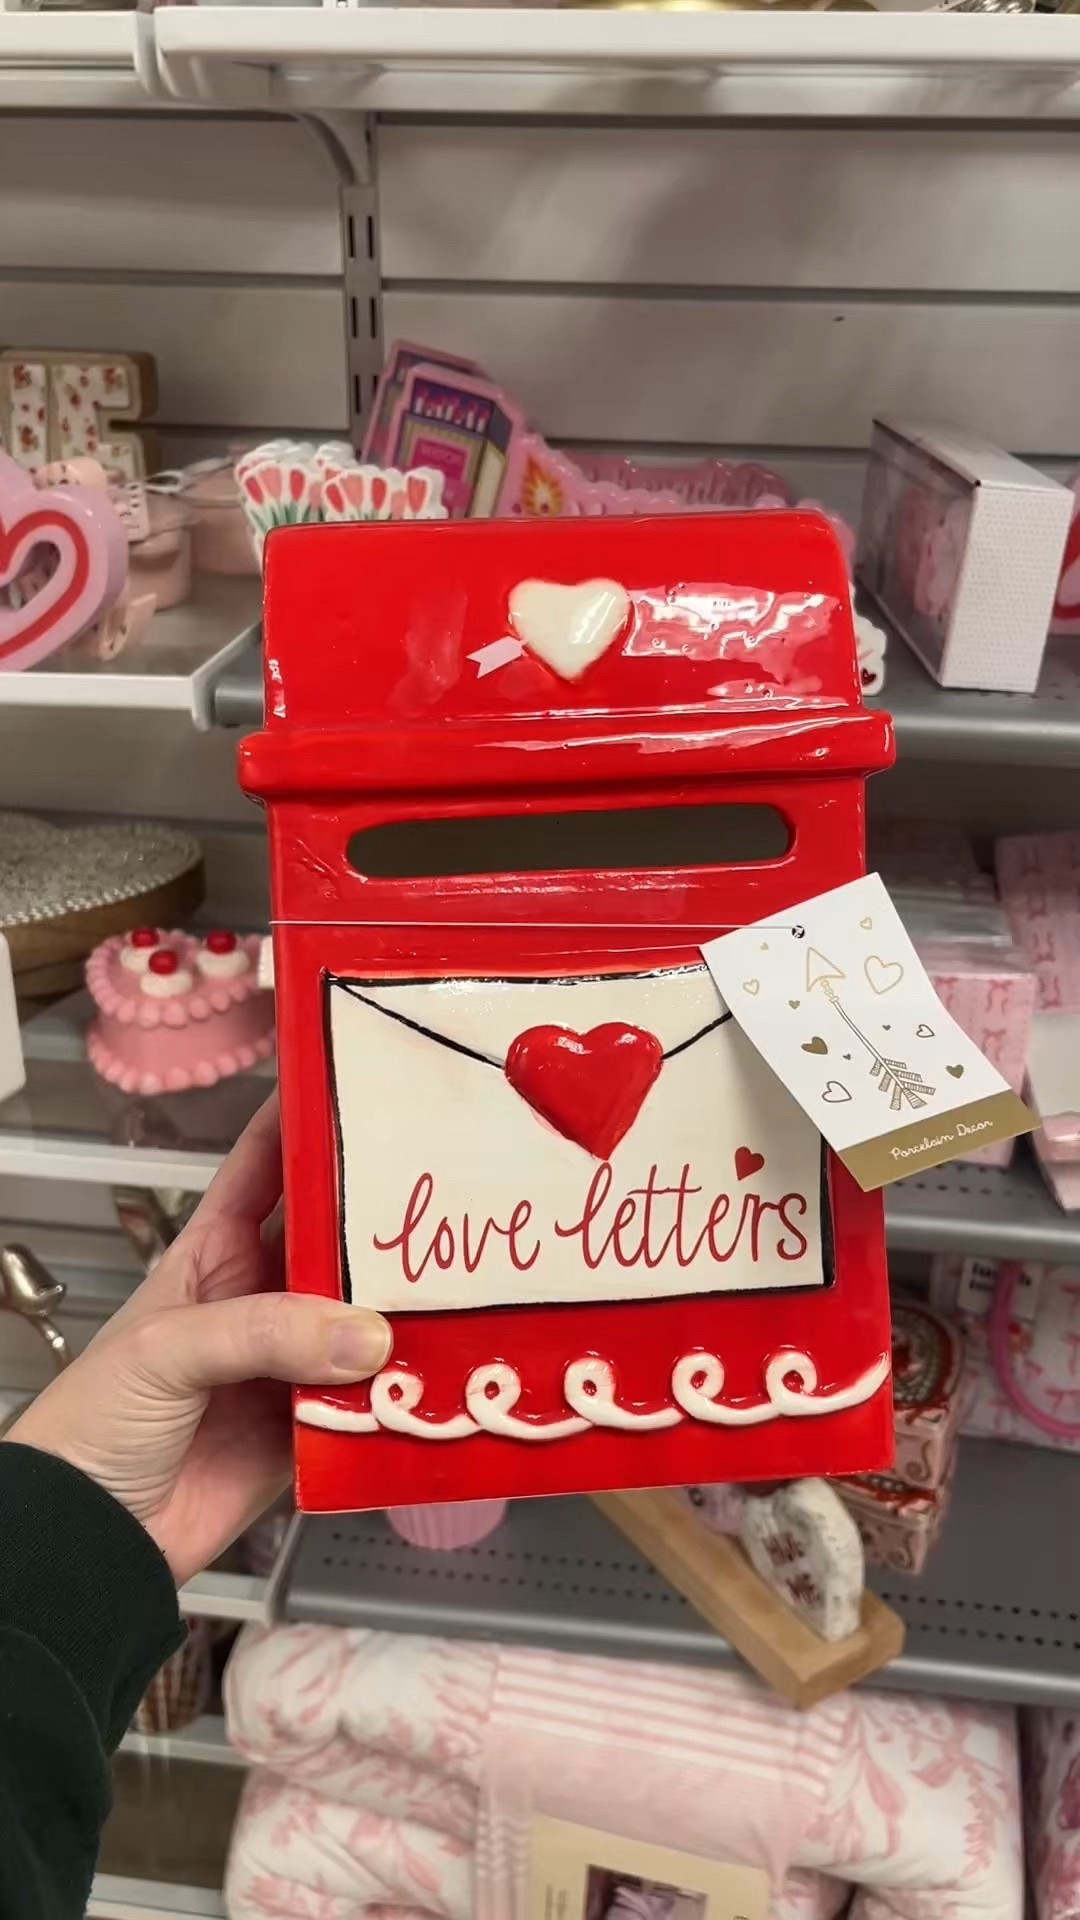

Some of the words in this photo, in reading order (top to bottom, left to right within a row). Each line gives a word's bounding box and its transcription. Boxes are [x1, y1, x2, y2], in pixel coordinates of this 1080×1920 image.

[890, 1134, 954, 1160] Porcelain
[373, 1172, 541, 1283] love
[555, 1162, 808, 1269] letters
